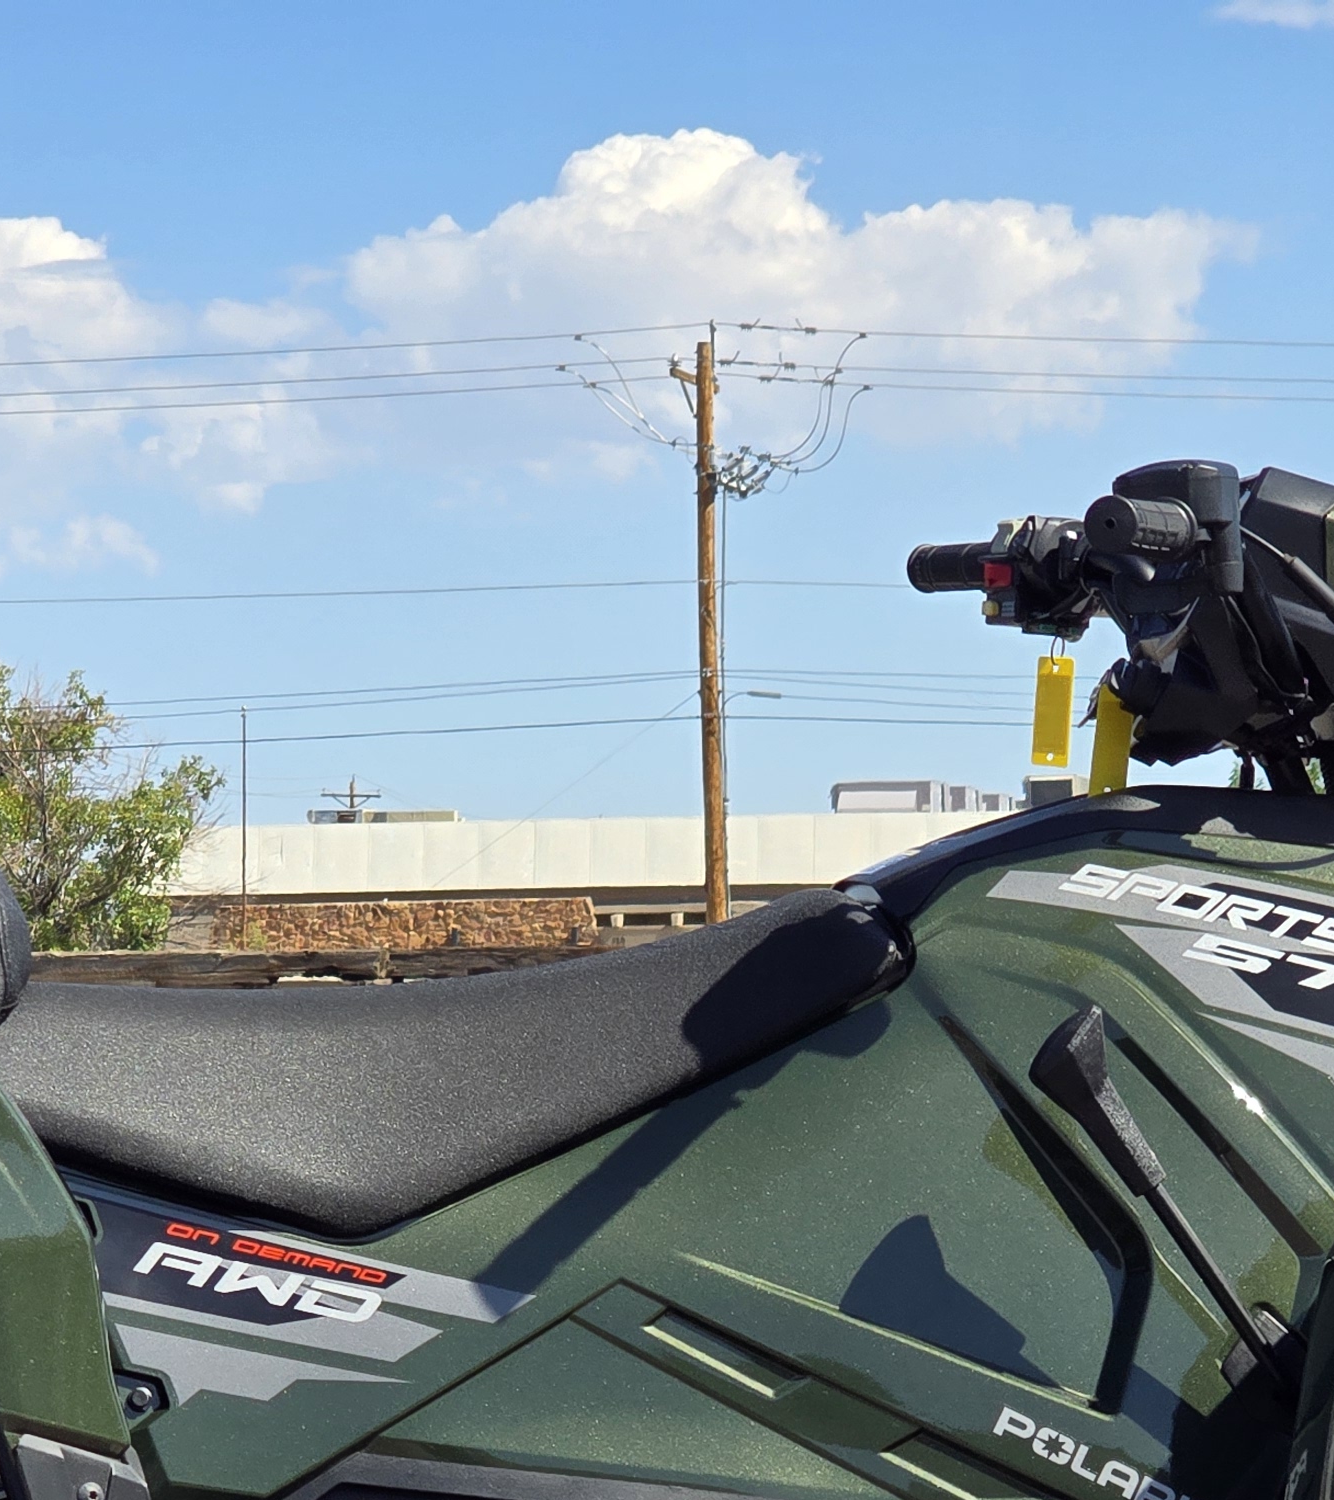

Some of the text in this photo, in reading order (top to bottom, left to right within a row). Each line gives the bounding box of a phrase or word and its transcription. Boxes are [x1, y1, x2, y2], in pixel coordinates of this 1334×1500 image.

[133, 1242, 382, 1322] AWD
[166, 1223, 386, 1284] ON DEMAND
